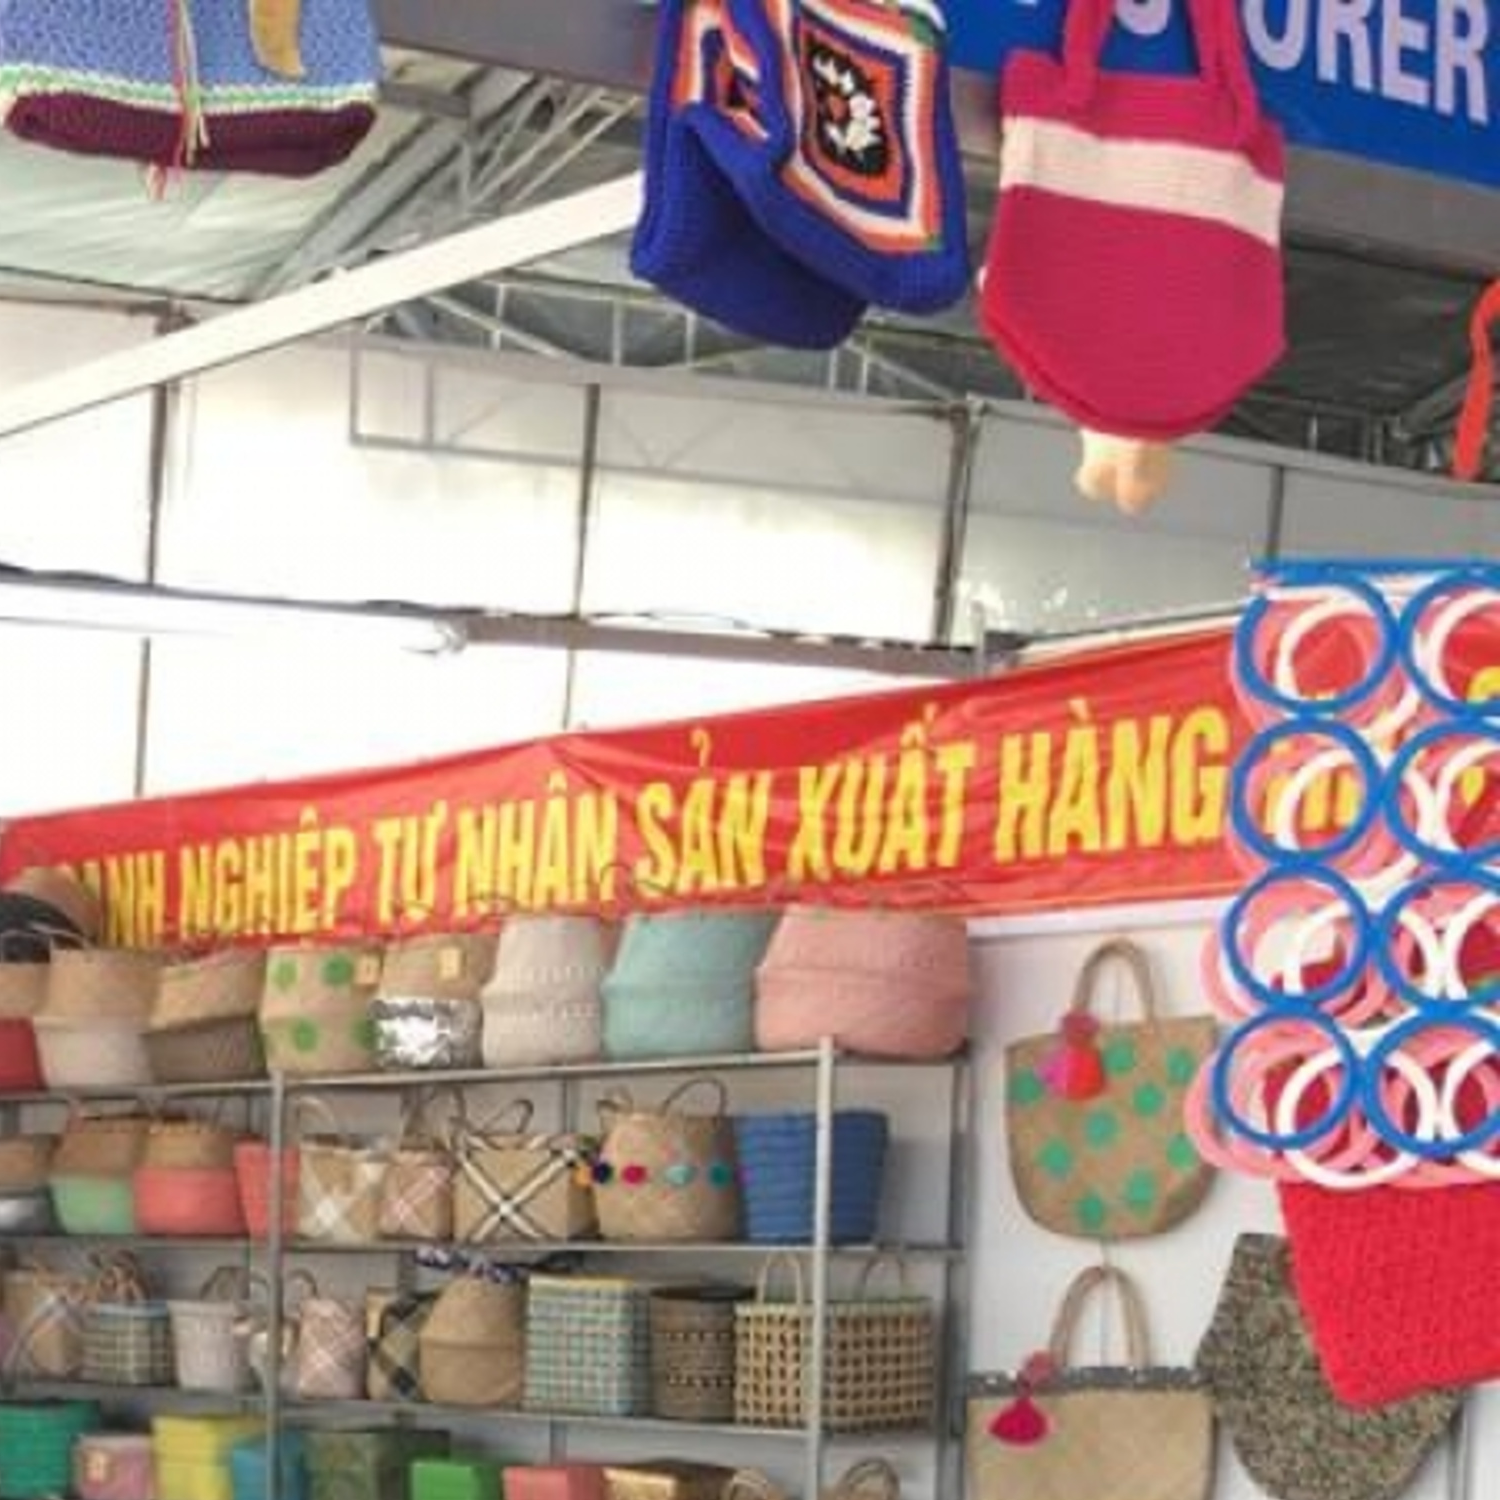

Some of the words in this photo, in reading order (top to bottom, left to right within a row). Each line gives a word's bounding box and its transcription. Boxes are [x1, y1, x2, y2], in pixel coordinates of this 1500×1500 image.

[1114, 0, 1489, 126] ORER
[453, 768, 619, 917] NHÂN
[633, 728, 773, 897] SẢN
[787, 702, 977, 881] XUẤT
[995, 696, 1230, 863] HÀNG
